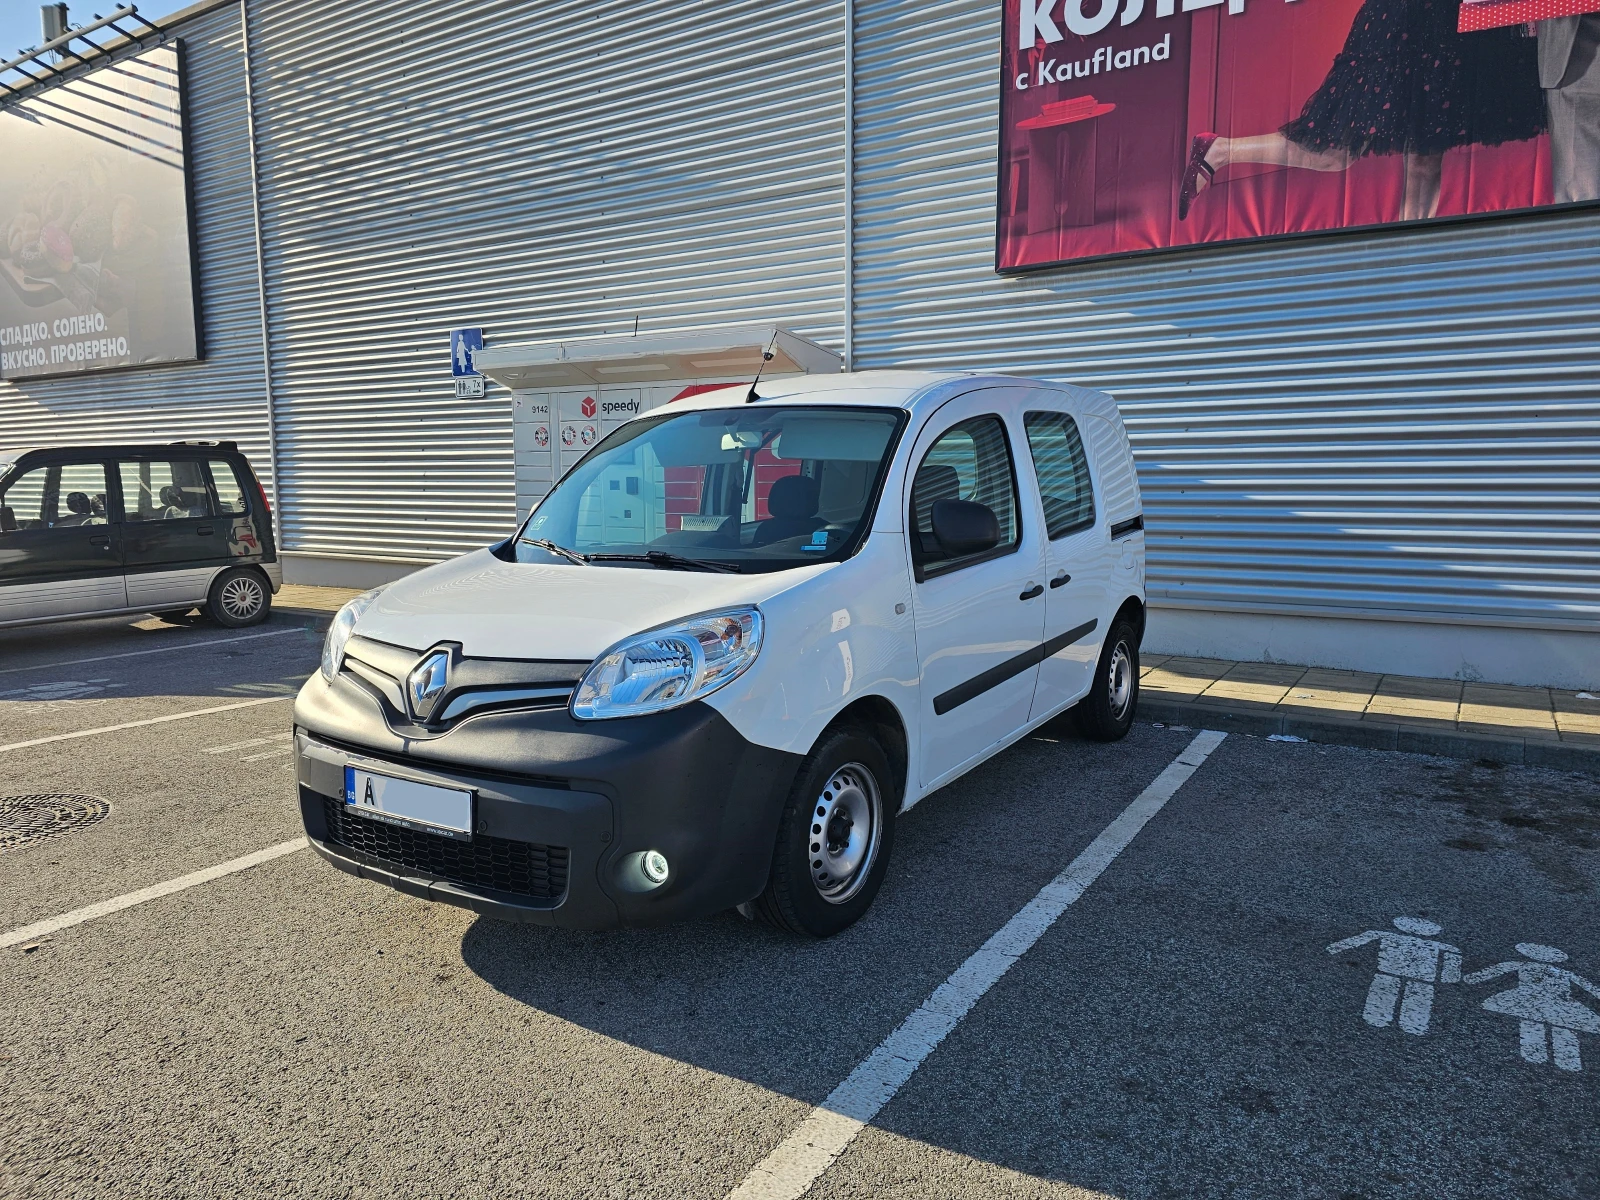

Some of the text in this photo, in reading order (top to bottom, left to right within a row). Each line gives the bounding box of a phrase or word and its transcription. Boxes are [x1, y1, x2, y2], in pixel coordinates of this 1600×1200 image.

[1039, 33, 1171, 86] Kaufland
[0, 312, 108, 346] СЛАДКО. СОЛЕНО.
[1, 336, 131, 370] ВКУСНО. ПРОВЕРЕНО.
[531, 405, 549, 414] 9142
[602, 398, 640, 414] speedy
